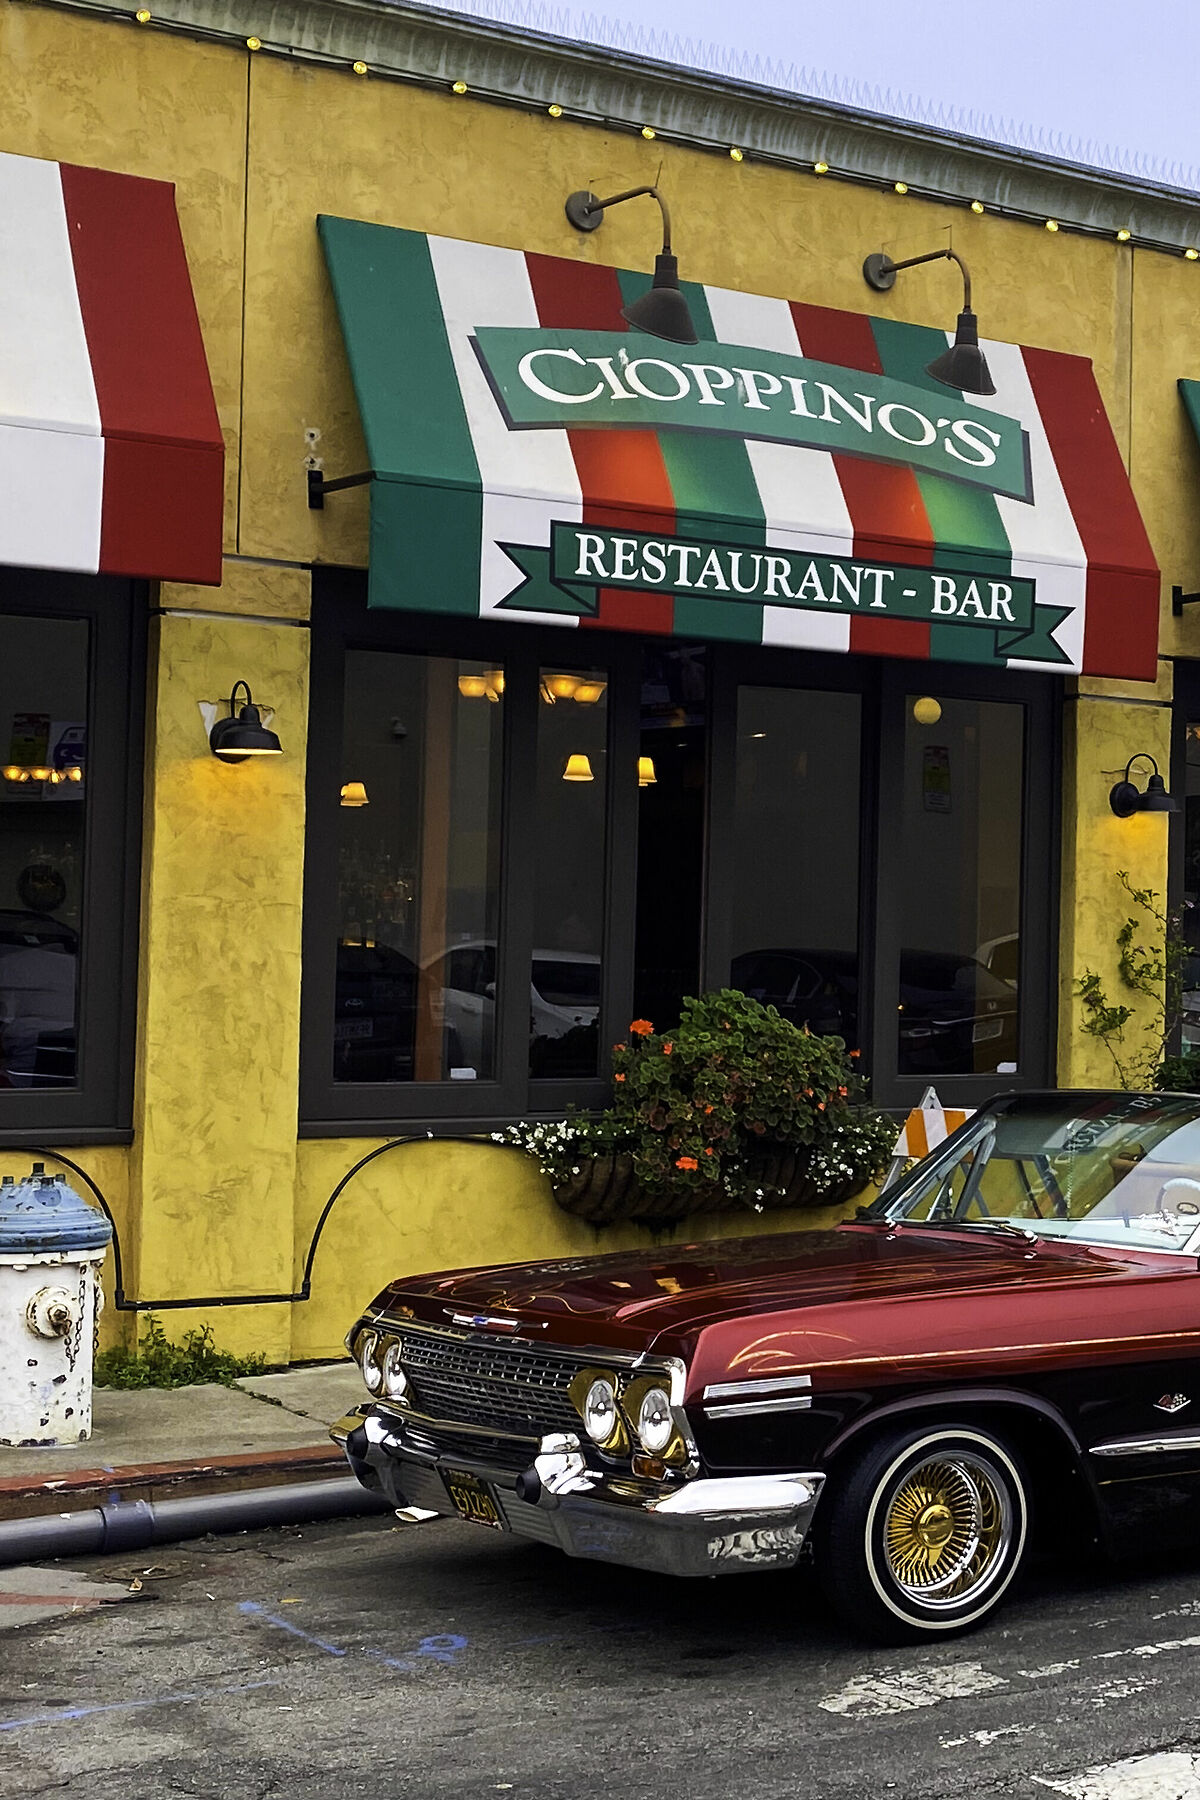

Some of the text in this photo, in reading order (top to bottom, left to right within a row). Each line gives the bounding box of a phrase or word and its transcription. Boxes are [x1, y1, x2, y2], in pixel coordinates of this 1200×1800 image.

[518, 347, 1003, 468] CIOPPINO'S
[574, 532, 895, 609] RESTAURANT
[930, 575, 1017, 623] BAR
